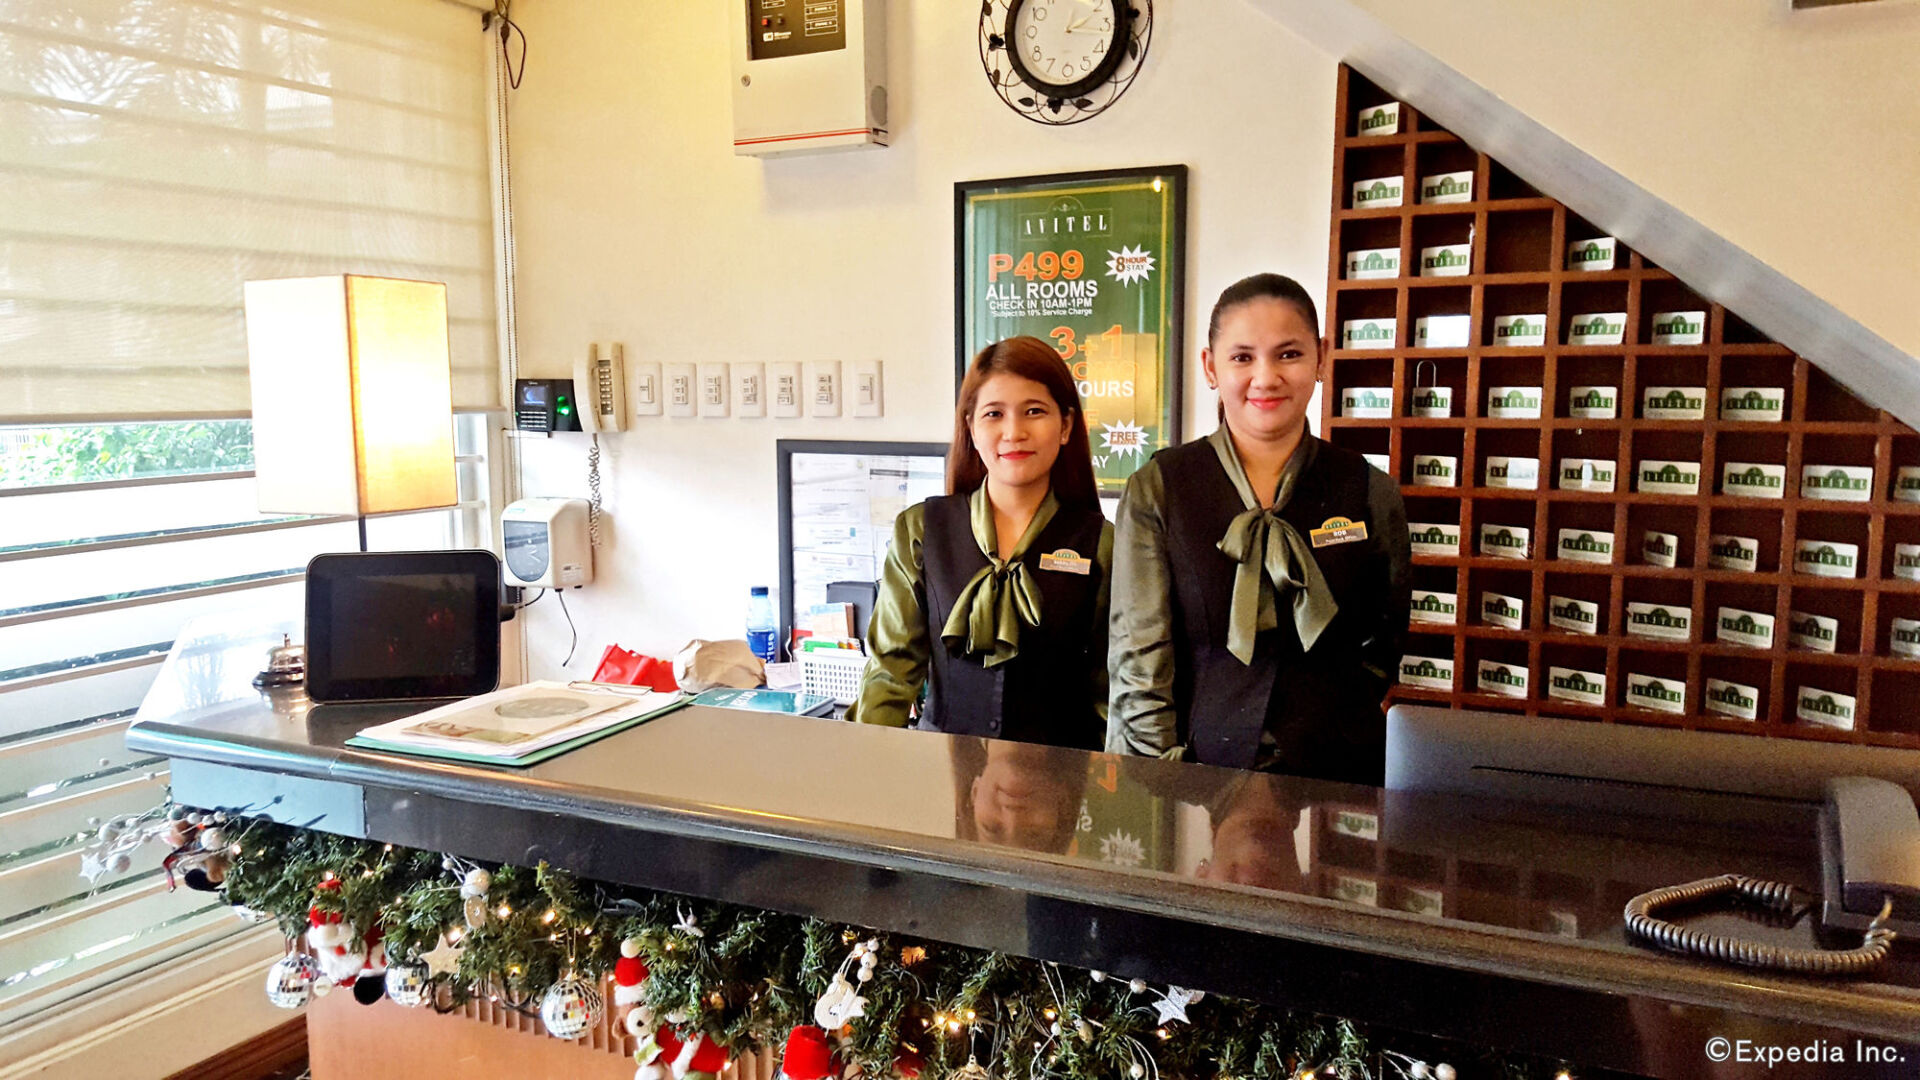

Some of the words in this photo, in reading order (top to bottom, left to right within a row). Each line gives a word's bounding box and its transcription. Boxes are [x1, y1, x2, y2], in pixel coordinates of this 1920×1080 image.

[1100, 17, 1111, 32] 3
[1092, 39, 1104, 53] 4
[1032, 46, 1042, 62] 8
[1046, 58, 1056, 73] 7
[1062, 62, 1074, 78] 6
[1080, 56, 1091, 71] 5
[1024, 214, 1107, 235] AVITEL
[988, 249, 1085, 282] P499
[1115, 256, 1126, 273] 8
[1125, 256, 1148, 264] HOUR
[985, 282, 1022, 301] ALL
[1026, 279, 1099, 299] ROOMS
[988, 300, 1025, 310] CHECK
[1027, 299, 1038, 309] IN
[1040, 297, 1093, 309] 10AM-1PM
[1042, 308, 1067, 316] Service
[1068, 307, 1093, 317] Charge
[1050, 323, 1123, 360] 3+1
[1109, 431, 1138, 442] FREE
[1091, 455, 1109, 469] AY
